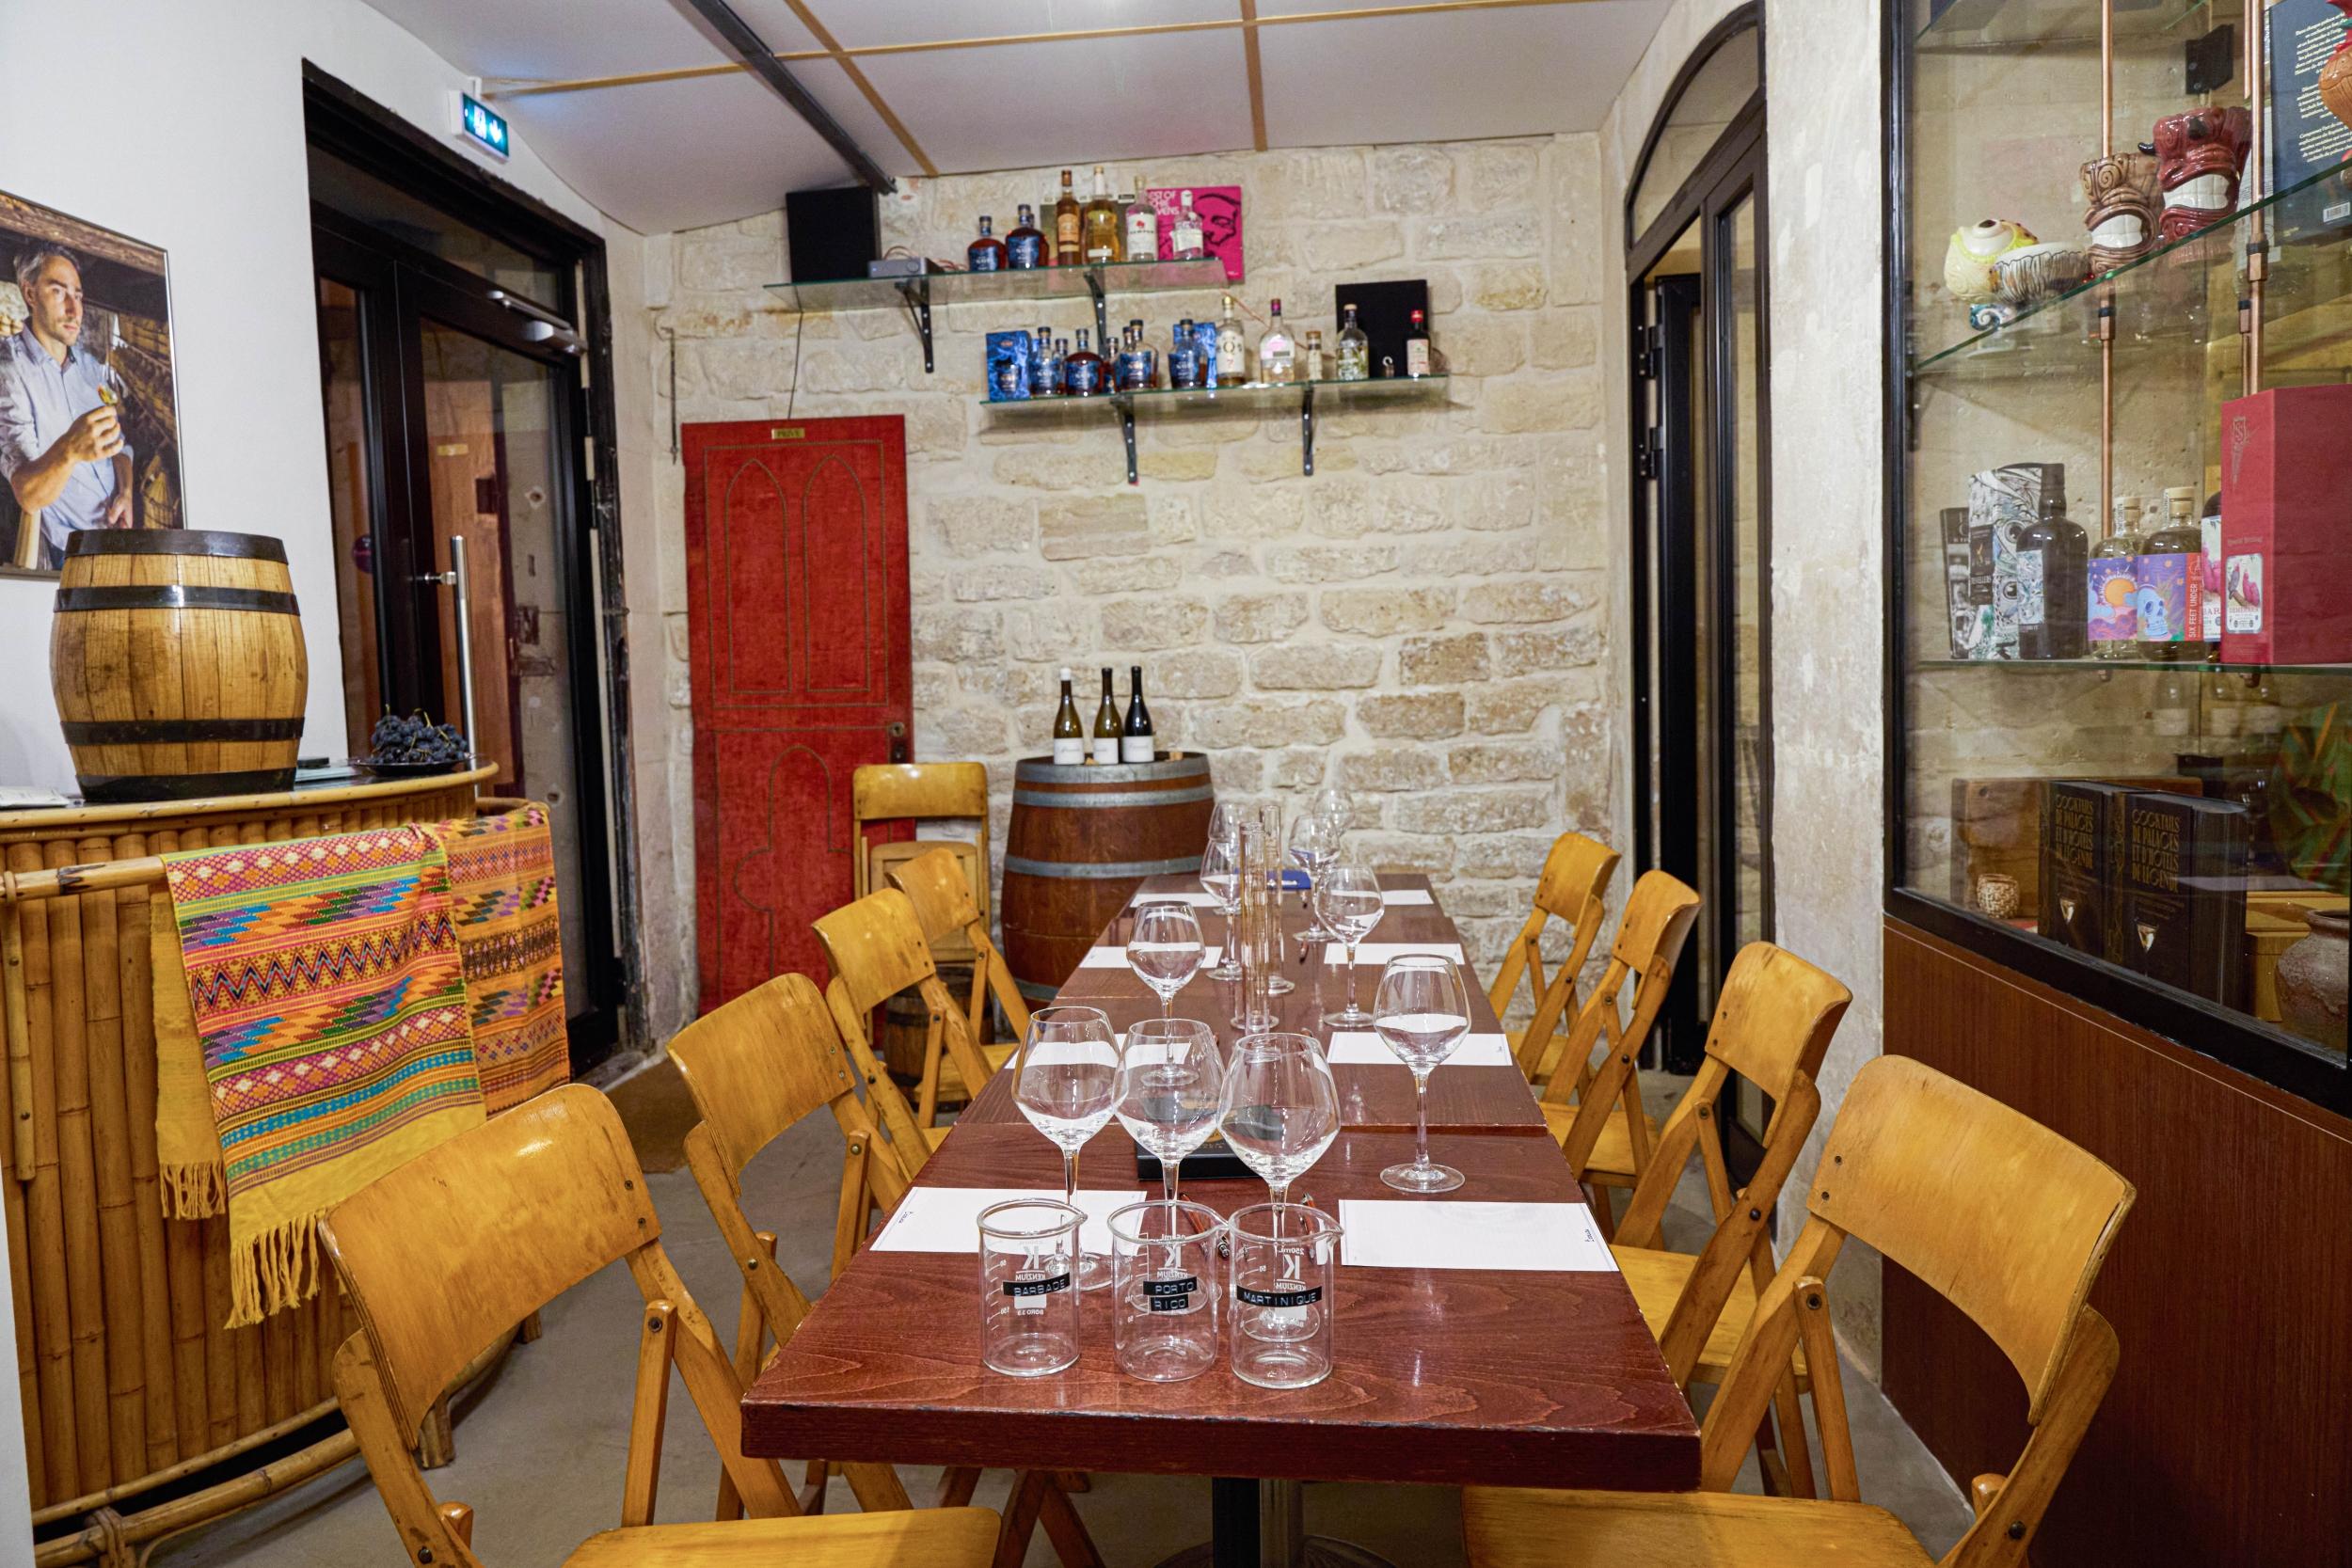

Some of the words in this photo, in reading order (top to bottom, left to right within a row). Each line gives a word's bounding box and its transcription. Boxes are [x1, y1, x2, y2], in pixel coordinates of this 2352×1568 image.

[2189, 583, 2198, 607] UNDER
[2188, 609, 2197, 625] FEET
[2188, 626, 2197, 638] SIX
[1013, 1278, 1066, 1296] BARBADE
[1155, 1281, 1195, 1294] PORTO
[1153, 1298, 1186, 1308] RICO
[1244, 1291, 1317, 1305] MARTINIQUE
